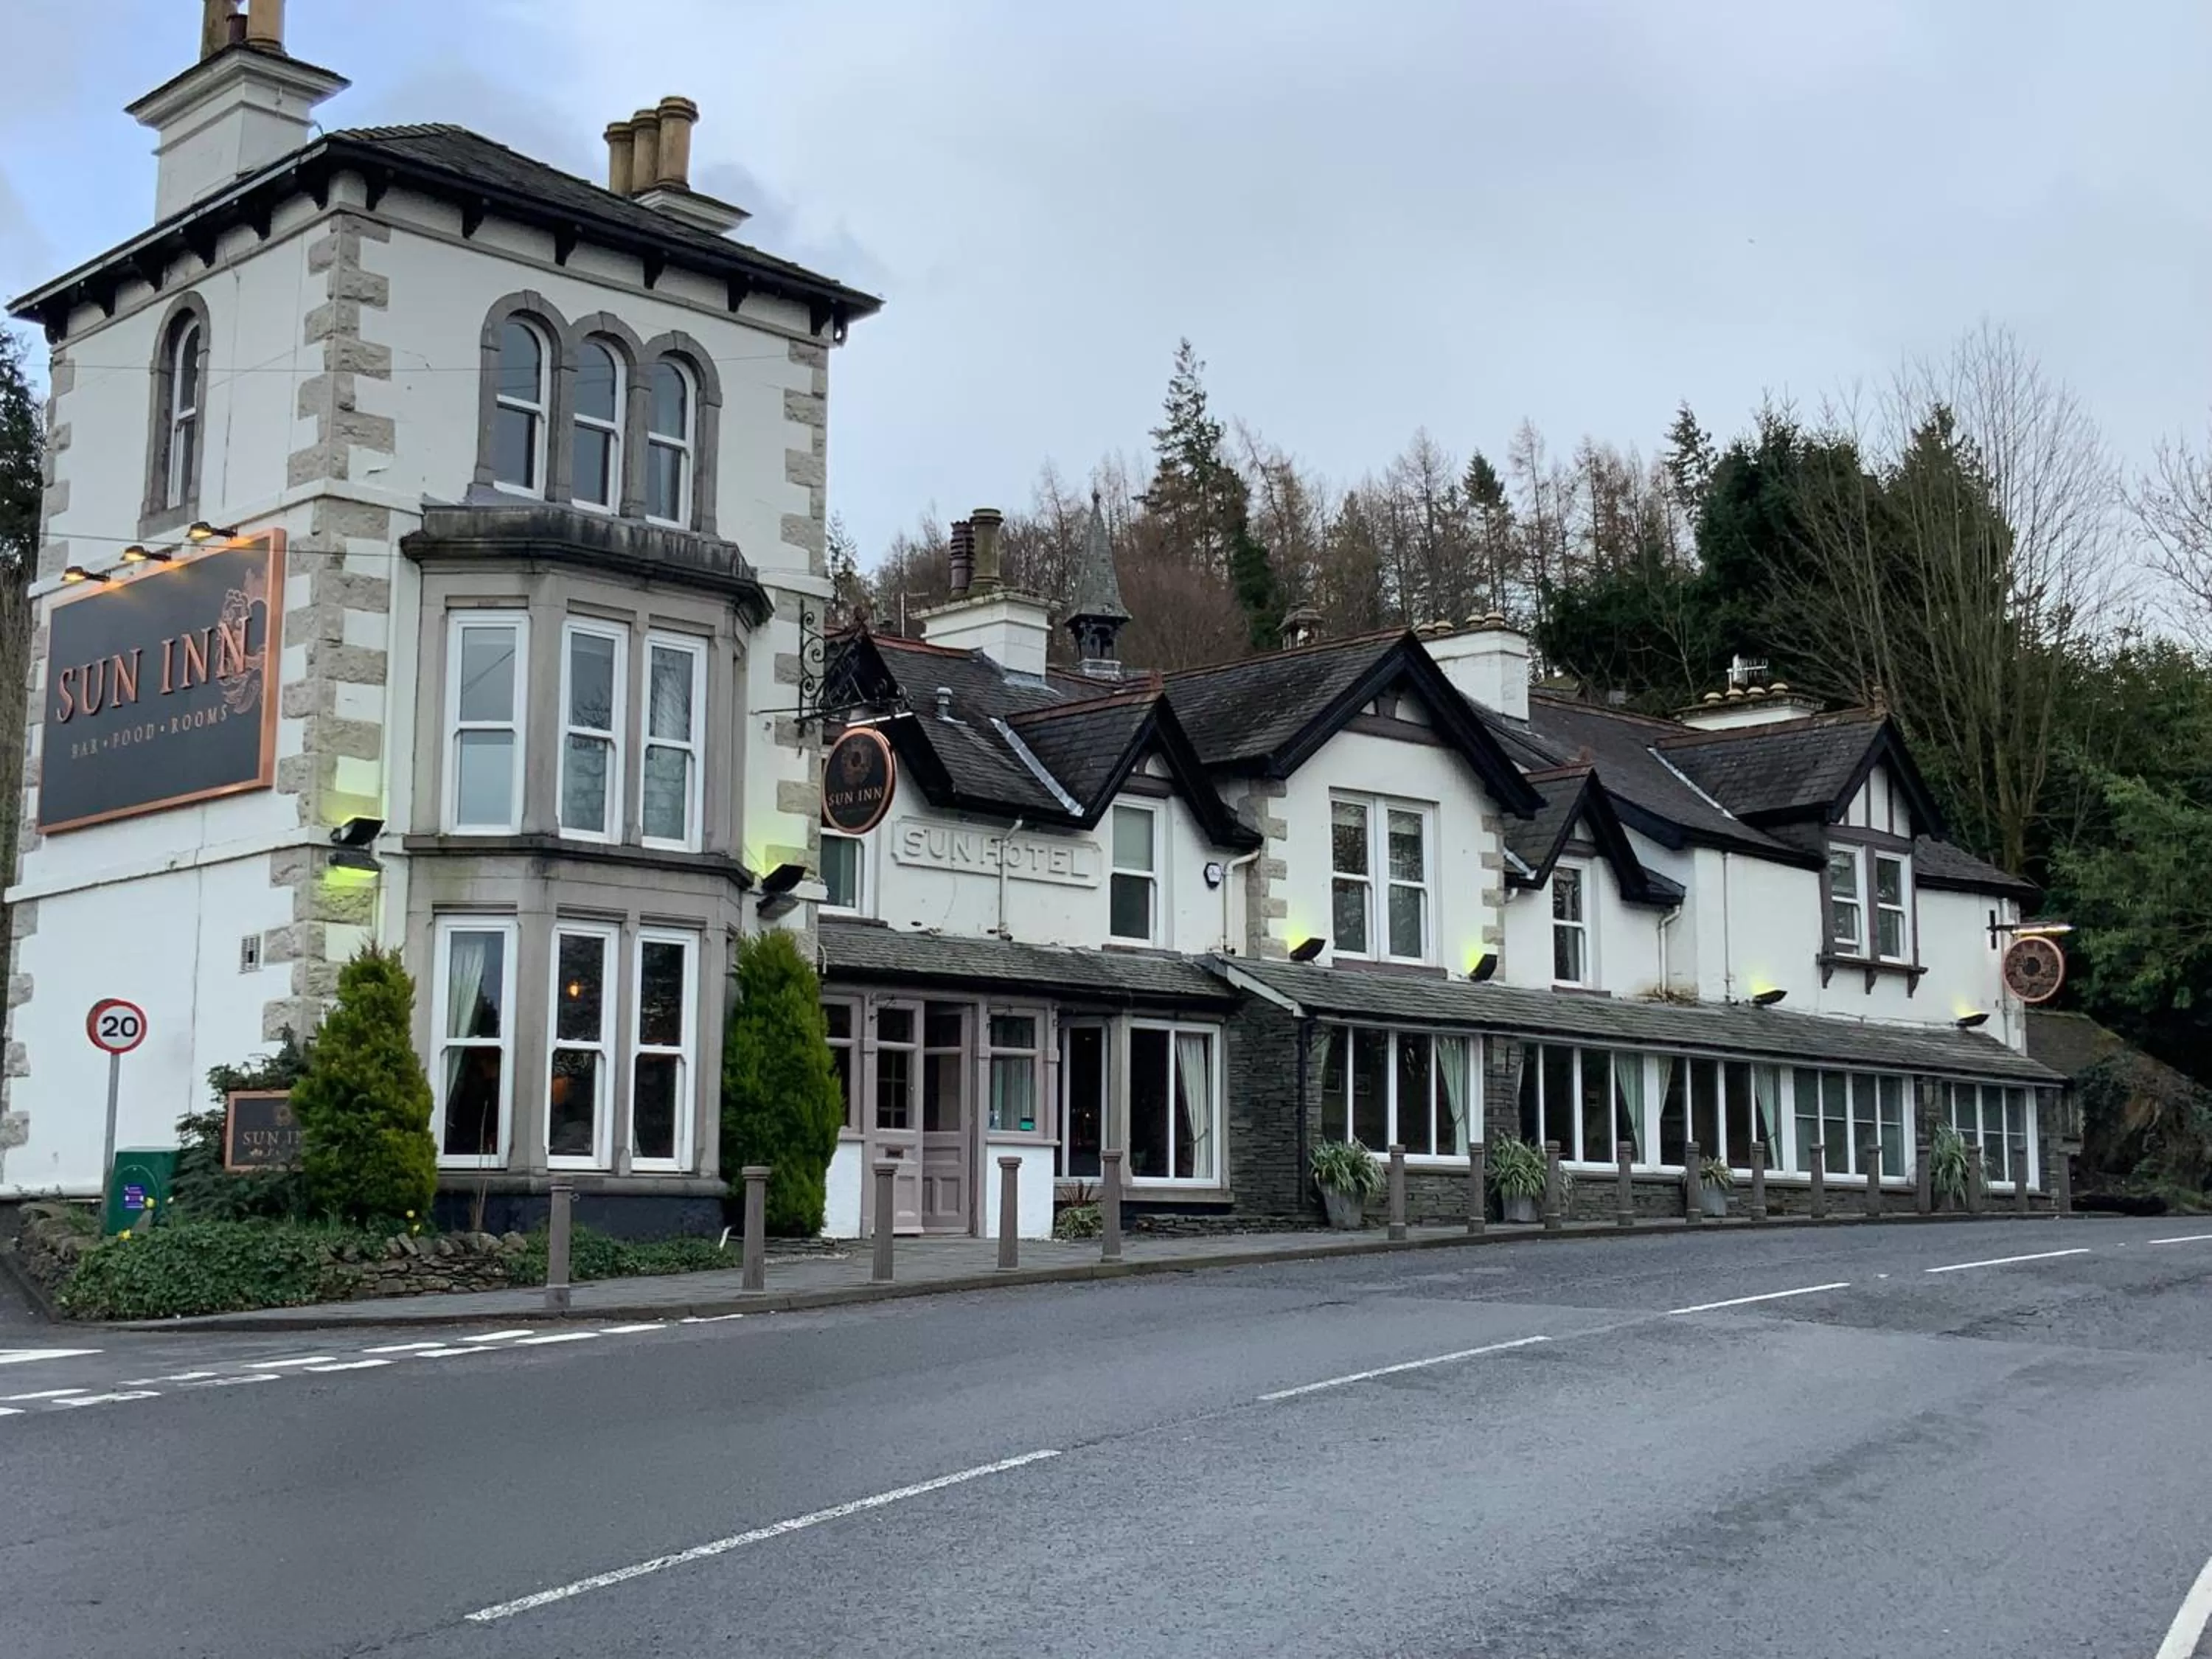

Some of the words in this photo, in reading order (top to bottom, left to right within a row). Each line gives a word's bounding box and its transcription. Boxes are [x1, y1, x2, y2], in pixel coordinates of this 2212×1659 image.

[56, 648, 143, 724] SUN
[158, 615, 252, 695] INN
[112, 723, 155, 749] FOOD
[170, 703, 229, 734] ROOMS
[828, 789, 854, 807] SUN
[858, 786, 883, 802] INN
[903, 828, 971, 862] SUN
[980, 838, 1089, 877] HOTEL
[102, 1016, 139, 1037] 20
[243, 1130, 279, 1145] SUN
